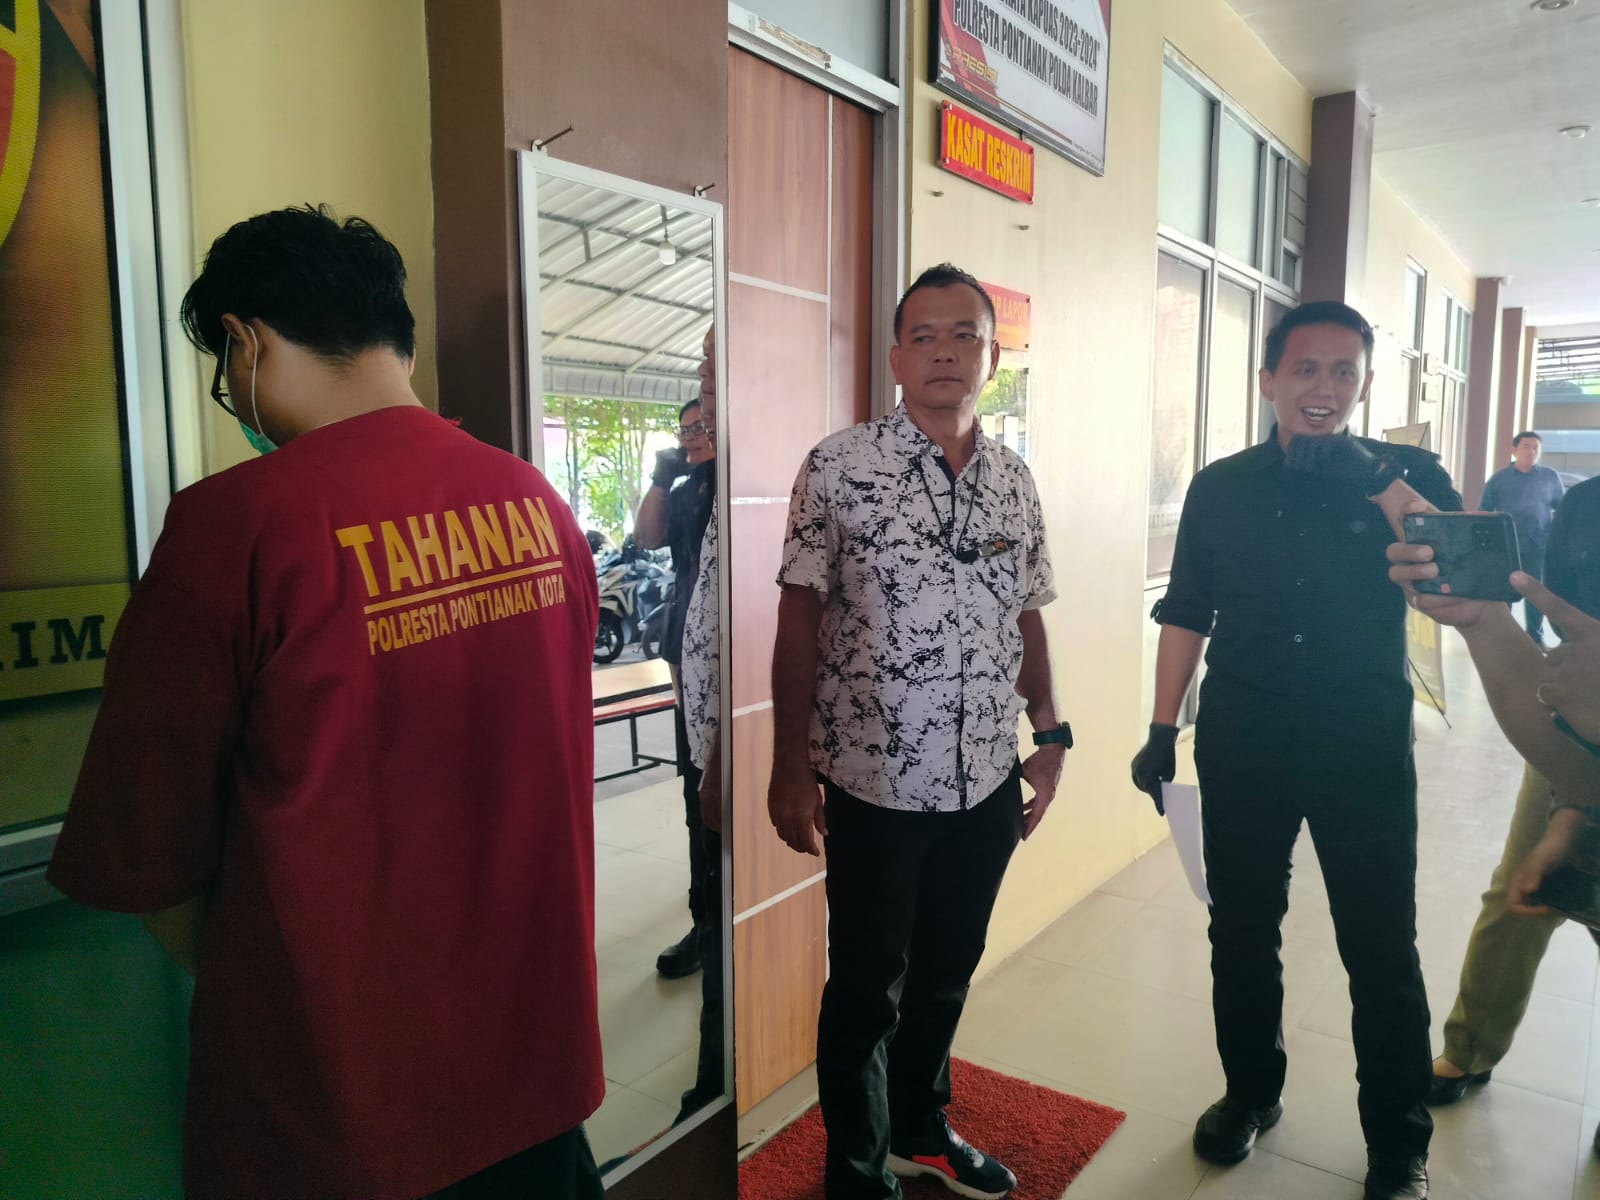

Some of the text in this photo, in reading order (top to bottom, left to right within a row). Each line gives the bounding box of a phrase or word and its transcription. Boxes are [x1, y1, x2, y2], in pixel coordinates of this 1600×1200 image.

[954, 0, 1098, 117] POLRESTA PONTIANAK POLDA KALBAR
[1027, 0, 1059, 42] KAPUAS
[947, 113, 1032, 195] KASAT RESKRIM
[335, 496, 561, 598] TAHANAN
[0, 613, 108, 671] IM
[367, 573, 567, 656] POLRESTA PONTIANAK KOTA
